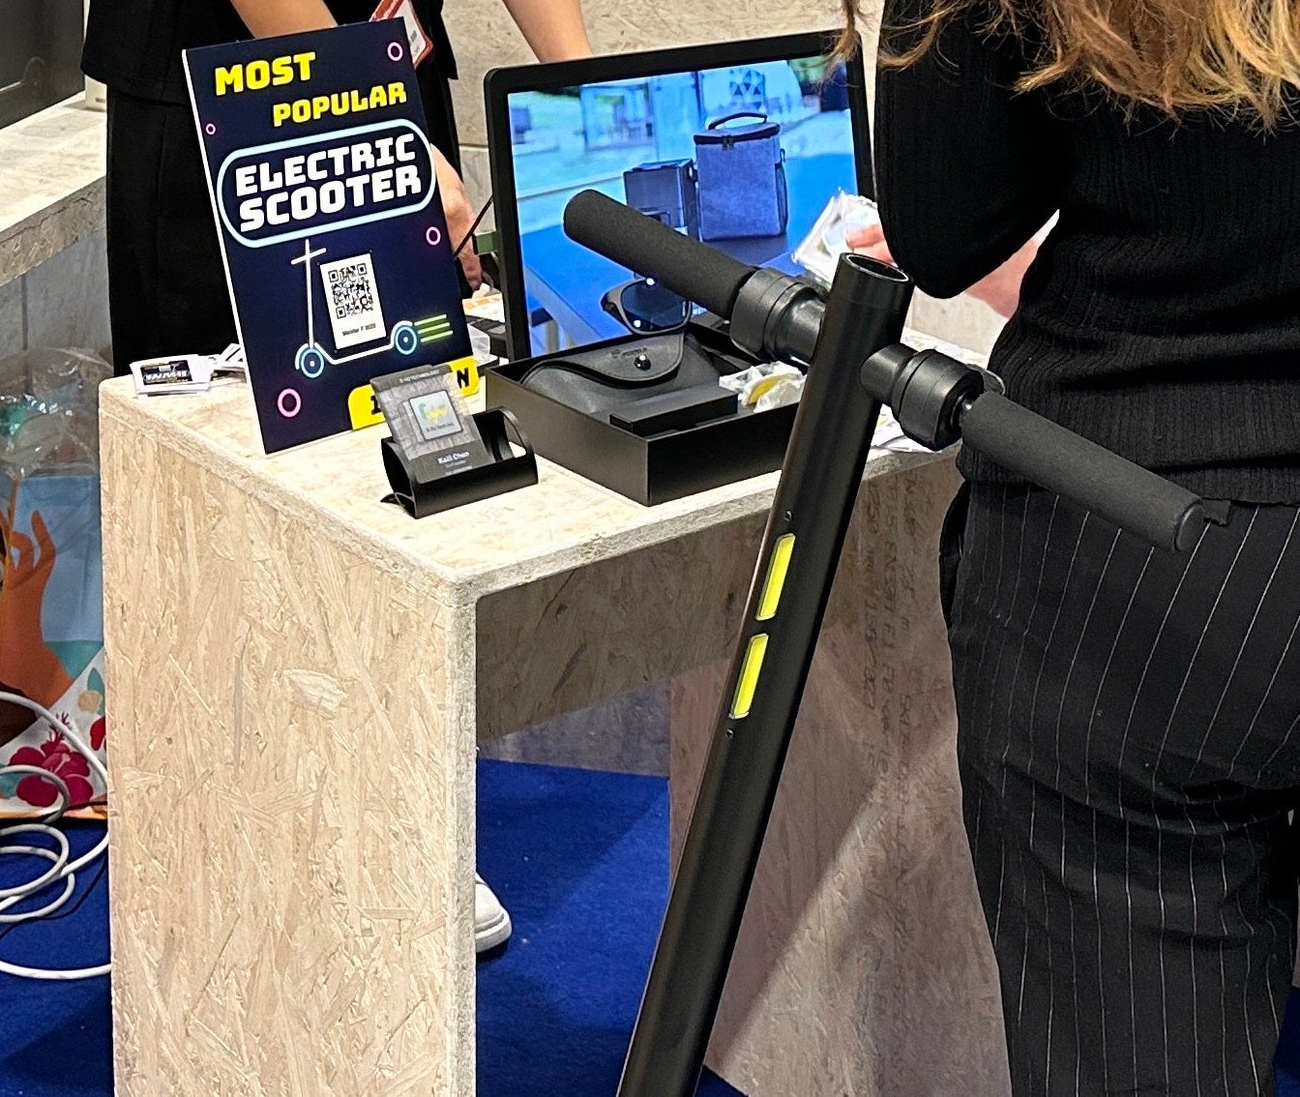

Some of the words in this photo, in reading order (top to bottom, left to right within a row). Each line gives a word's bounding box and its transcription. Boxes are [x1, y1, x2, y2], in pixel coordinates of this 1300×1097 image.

[214, 52, 317, 96] MOST
[272, 81, 408, 129] POPULAR
[234, 132, 417, 197] ELECTRIC
[238, 165, 422, 233] SCOOTER
